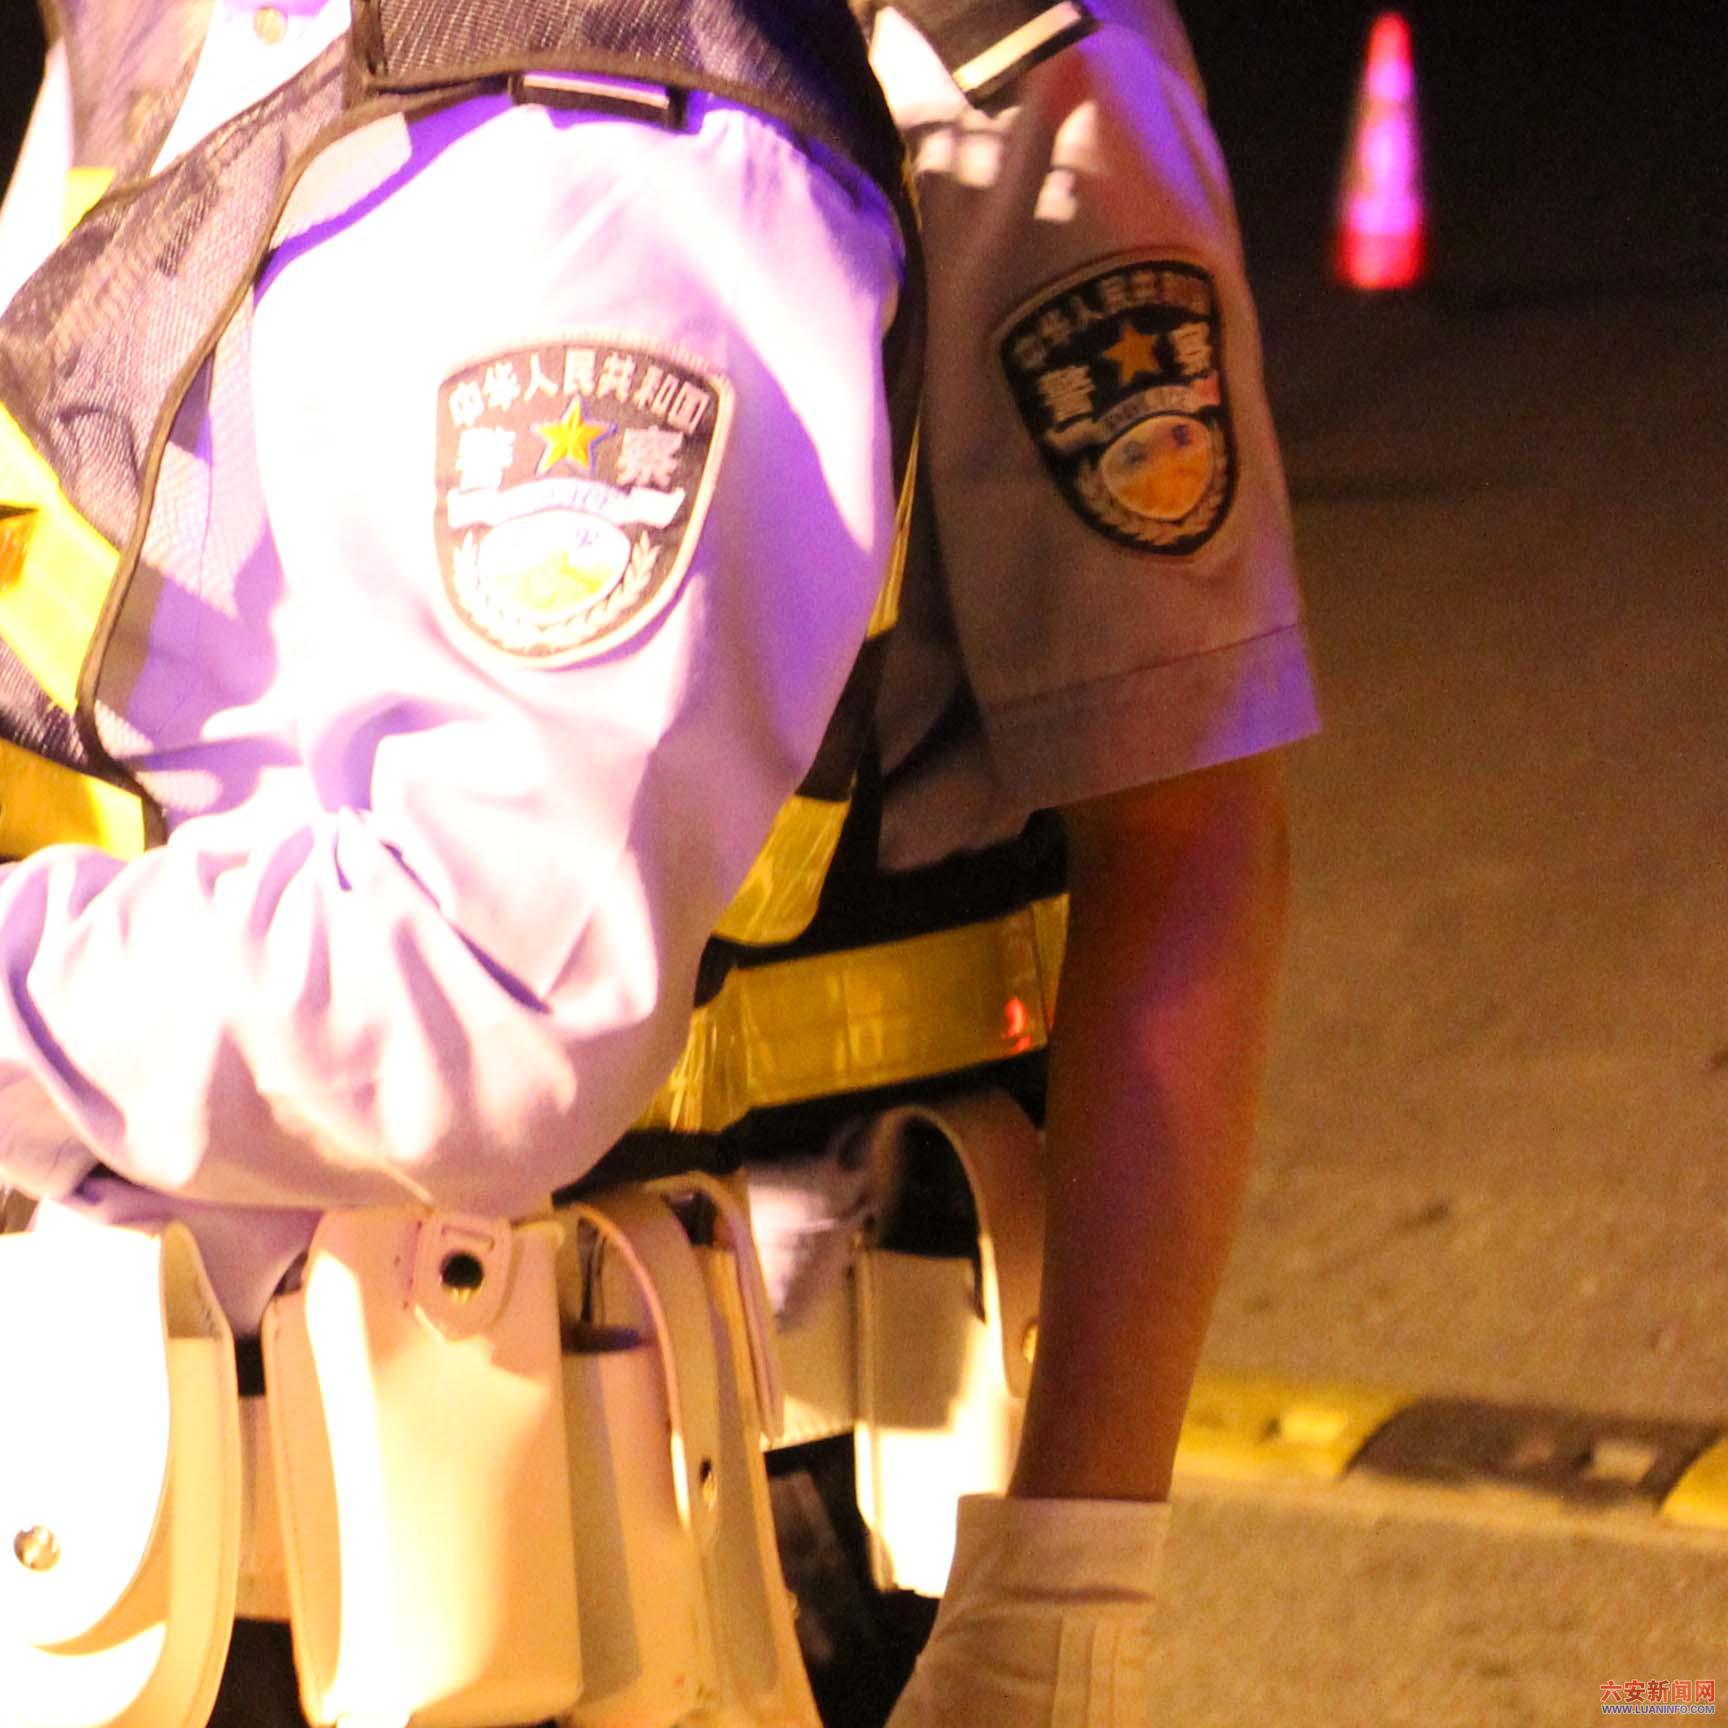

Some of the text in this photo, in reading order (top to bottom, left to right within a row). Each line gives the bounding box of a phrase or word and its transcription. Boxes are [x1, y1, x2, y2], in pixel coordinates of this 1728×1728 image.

[448, 348, 710, 435] 中华人民共和国
